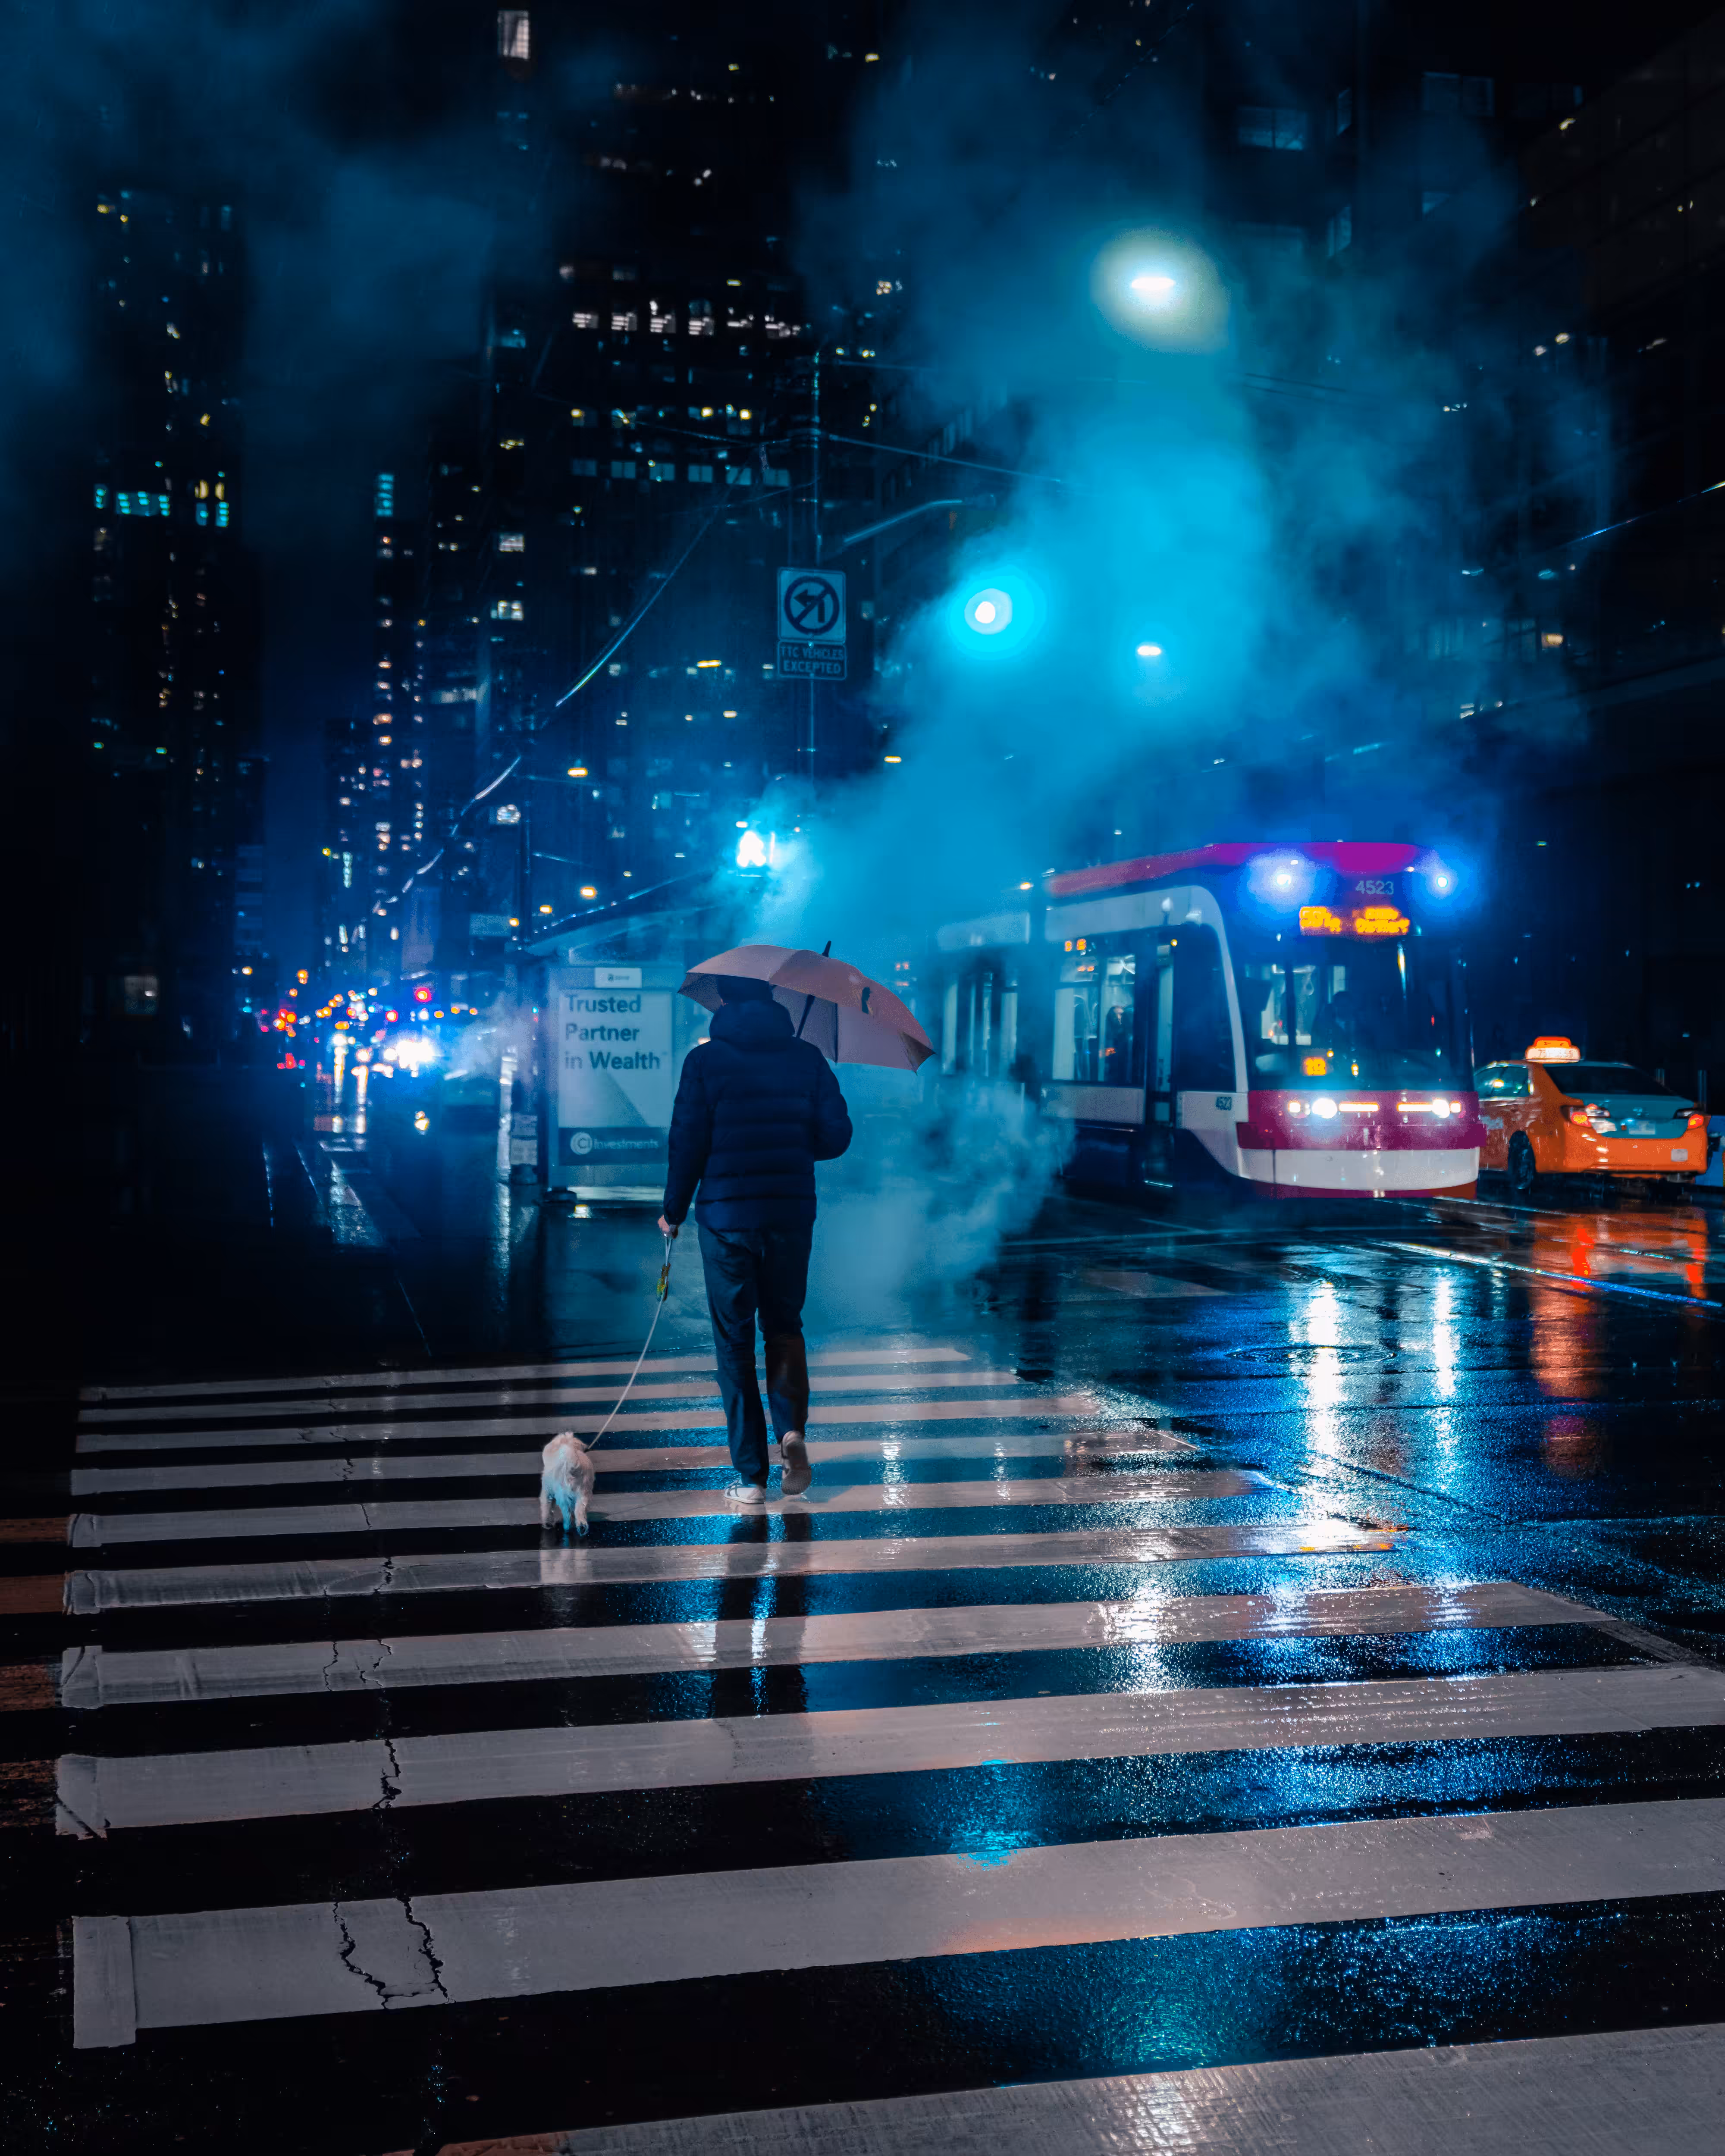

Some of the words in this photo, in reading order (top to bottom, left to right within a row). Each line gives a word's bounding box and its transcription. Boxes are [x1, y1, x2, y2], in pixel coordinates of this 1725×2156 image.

[781, 647, 798, 658] TTC
[803, 648, 843, 660] VEHICLES
[784, 661, 841, 674] EXCEPTED
[1355, 880, 1394, 895] 4523
[565, 994, 641, 1012] Trusted
[566, 1023, 640, 1041] Partner
[565, 1051, 583, 1069] in
[589, 1051, 660, 1069] Wealth
